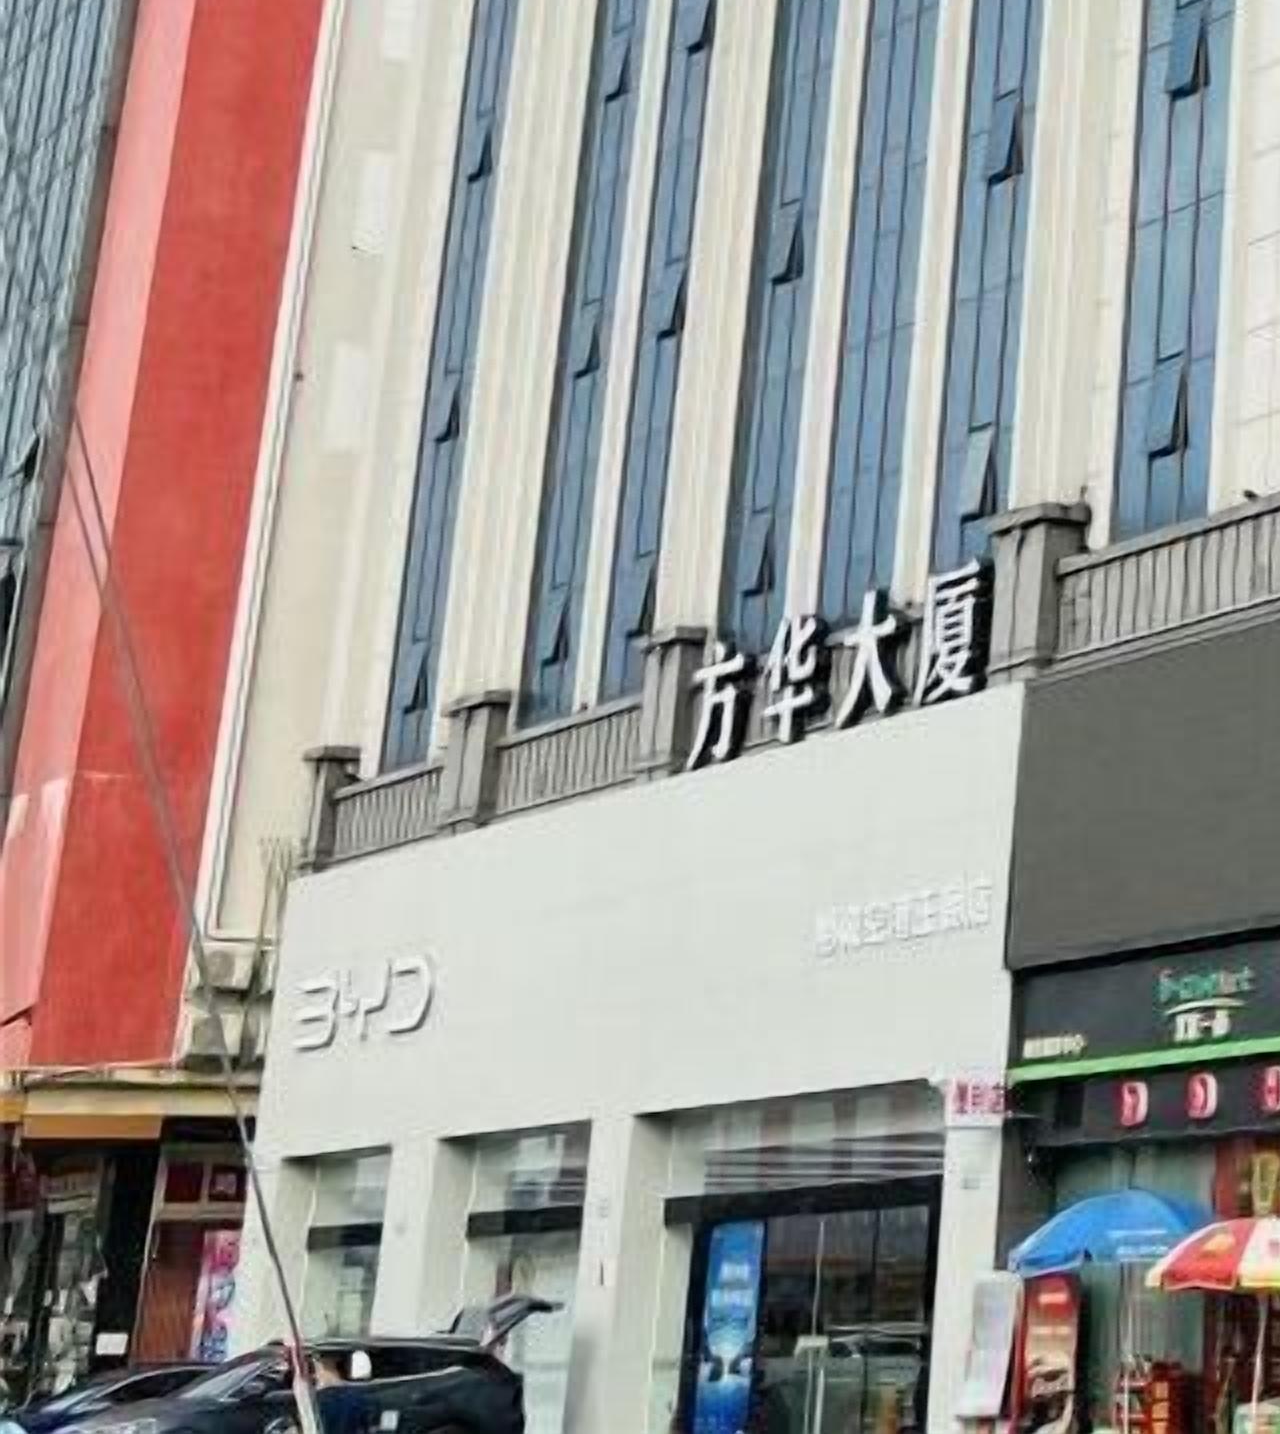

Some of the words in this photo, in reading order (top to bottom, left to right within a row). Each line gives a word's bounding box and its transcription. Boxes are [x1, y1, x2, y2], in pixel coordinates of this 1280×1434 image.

[686, 558, 981, 772] 方华大厦
[291, 954, 434, 1052] BYD
